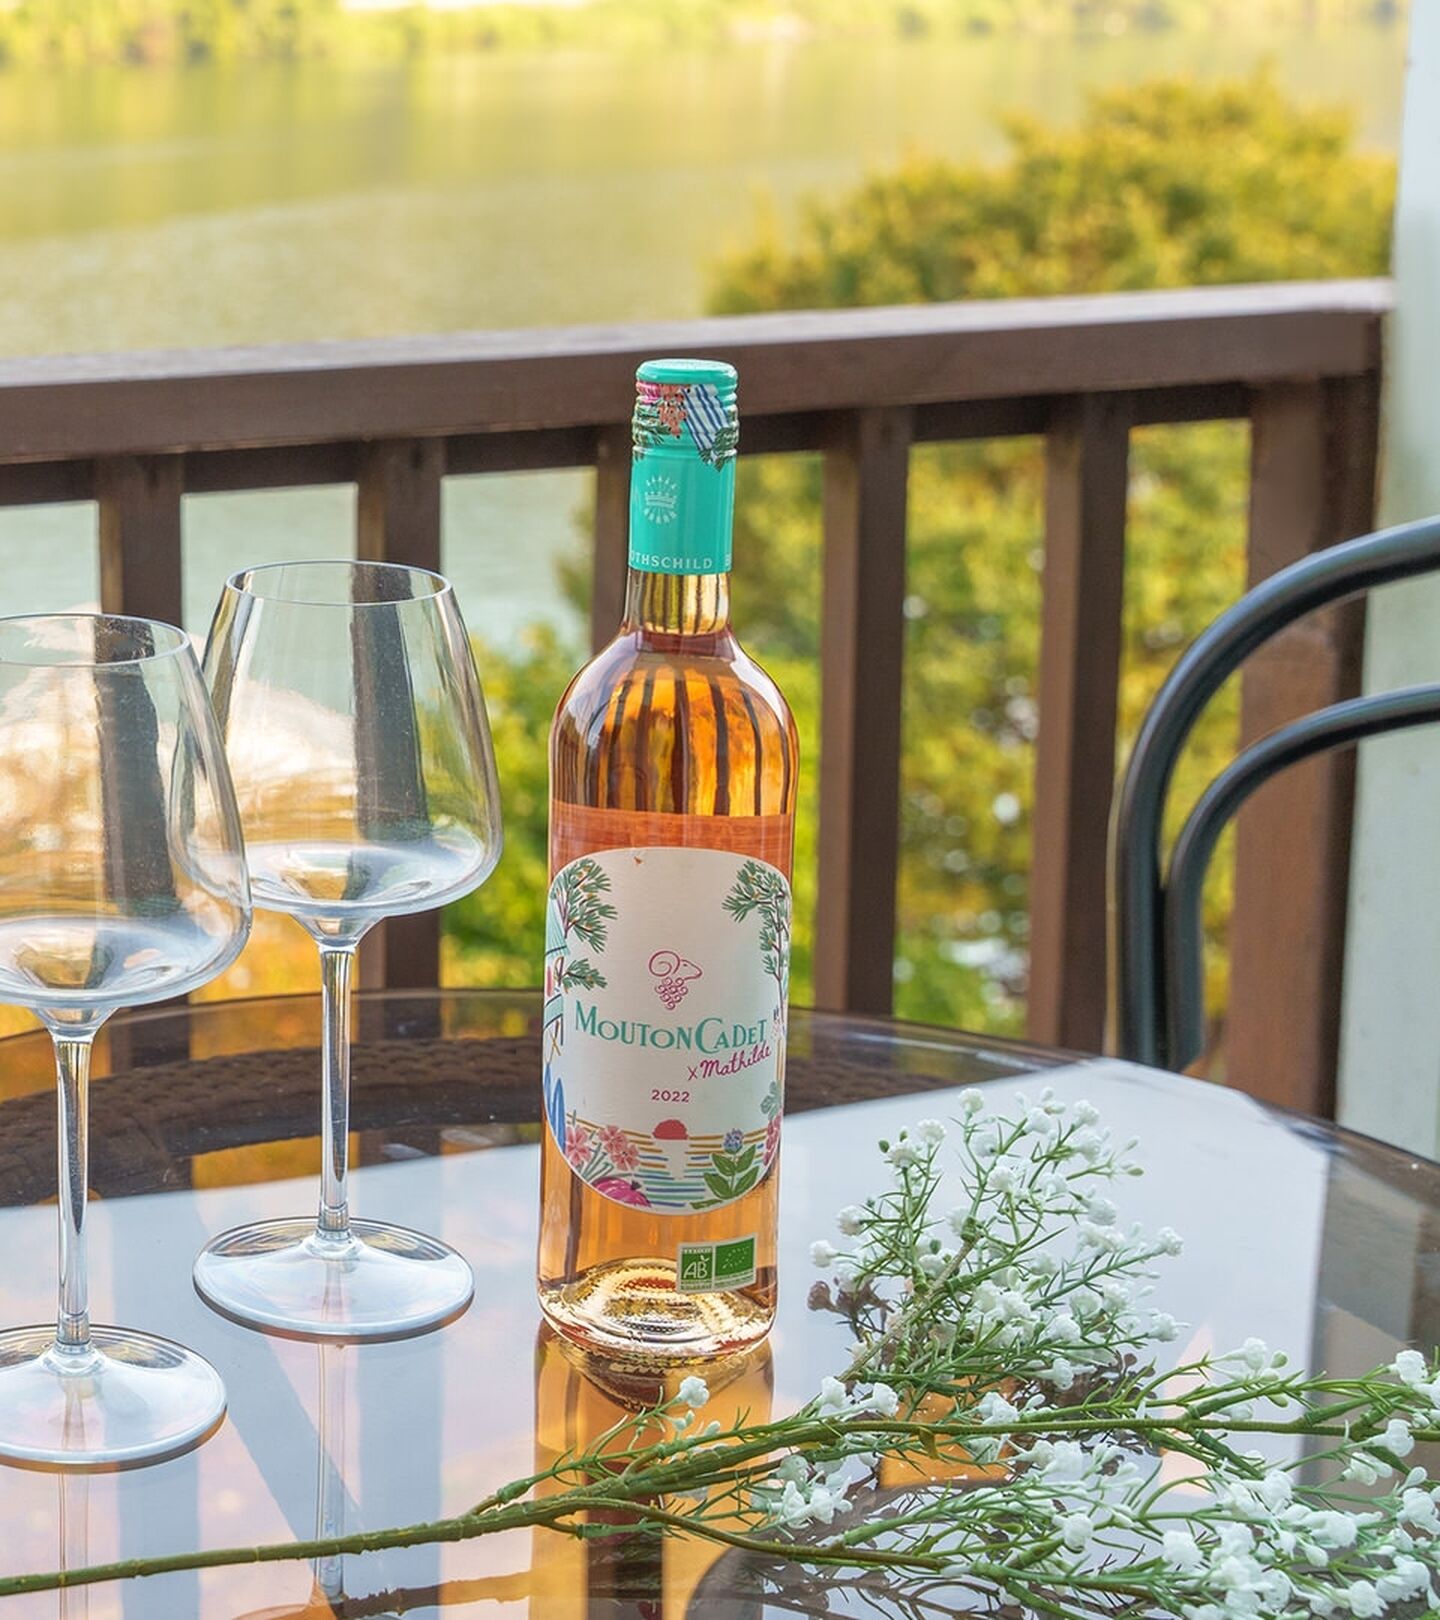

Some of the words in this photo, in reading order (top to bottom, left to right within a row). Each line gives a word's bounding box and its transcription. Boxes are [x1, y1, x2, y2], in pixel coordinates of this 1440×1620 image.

[700, 1041, 771, 1078] Mathilde
[651, 1089, 690, 1103] 2022
[683, 1260, 708, 1279] AB
